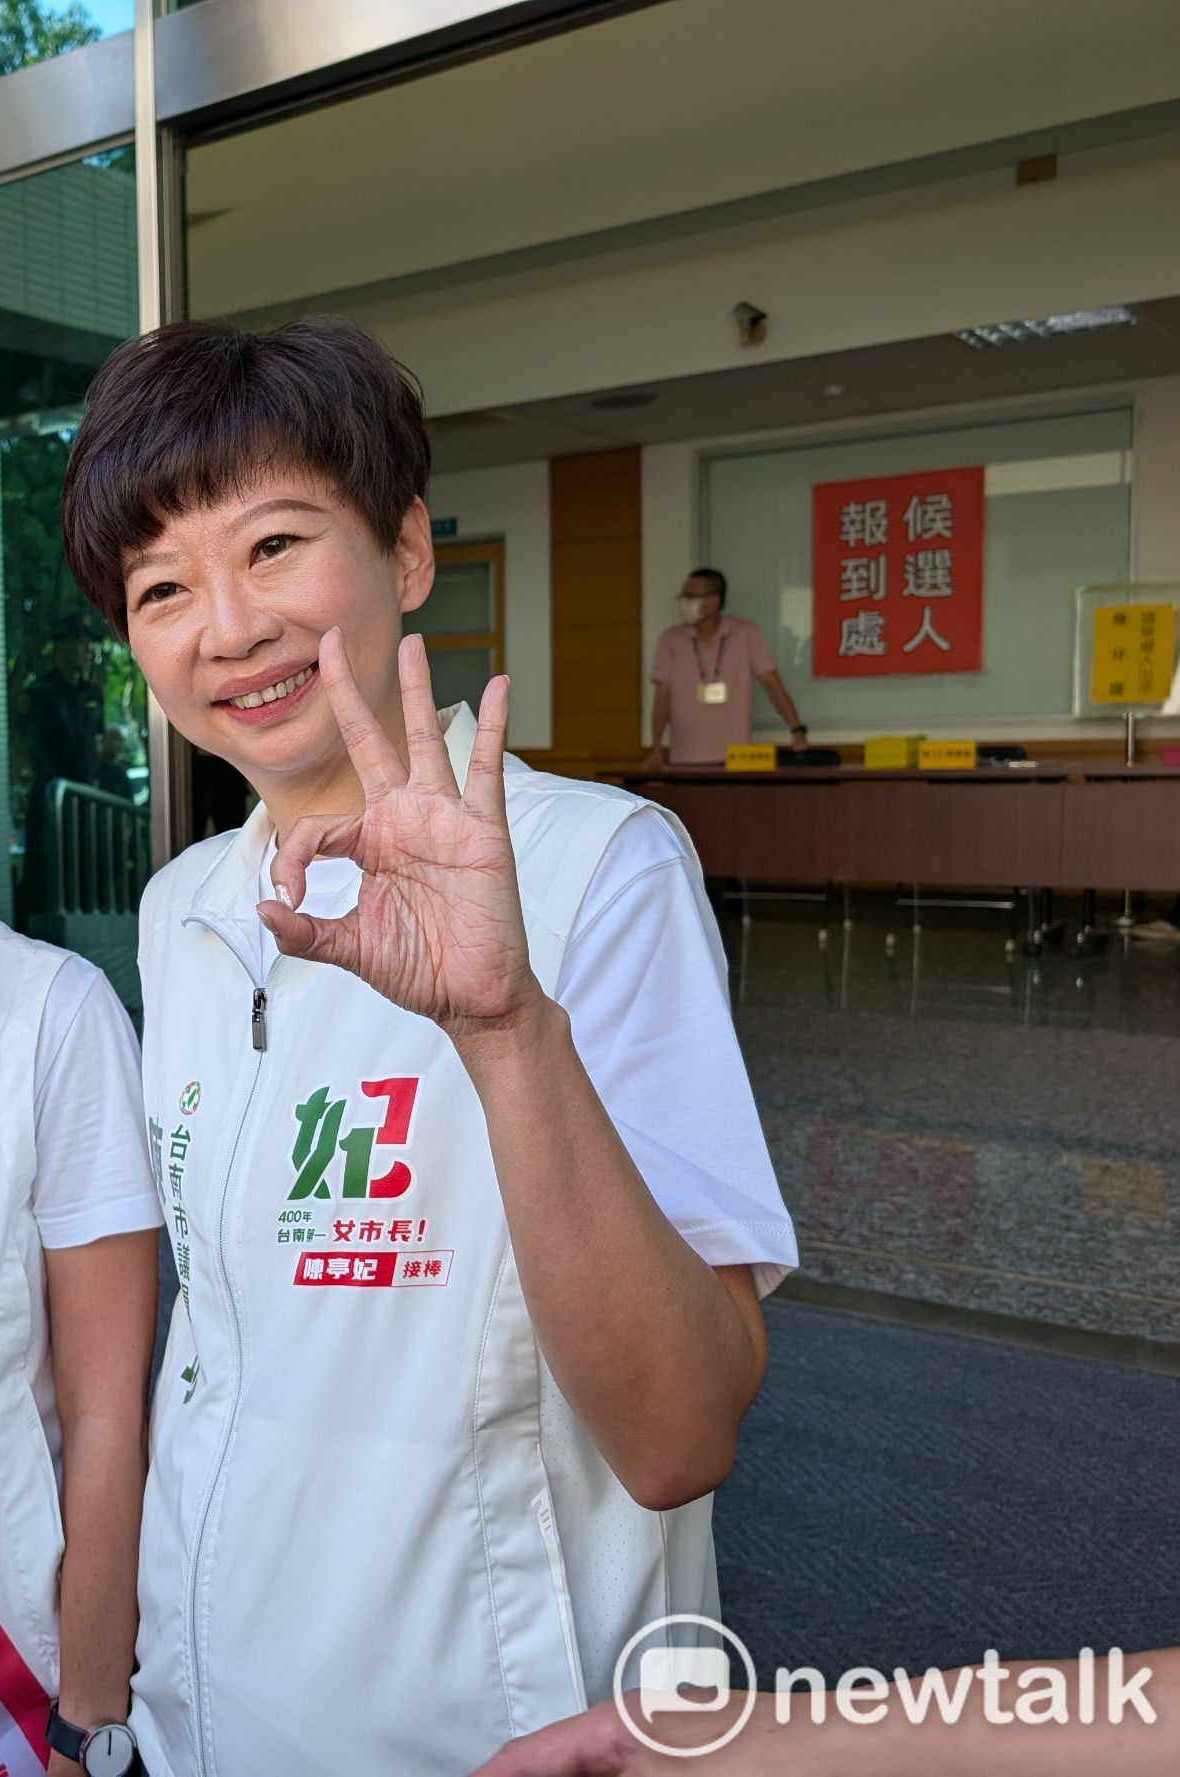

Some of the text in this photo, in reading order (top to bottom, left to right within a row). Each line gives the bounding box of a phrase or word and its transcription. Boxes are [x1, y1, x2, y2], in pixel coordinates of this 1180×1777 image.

[838, 501, 889, 657] 報到處
[902, 494, 954, 652] 候選人
[277, 1210, 312, 1223] 400年
[302, 1257, 442, 1281] 陳亭妃 接棒
